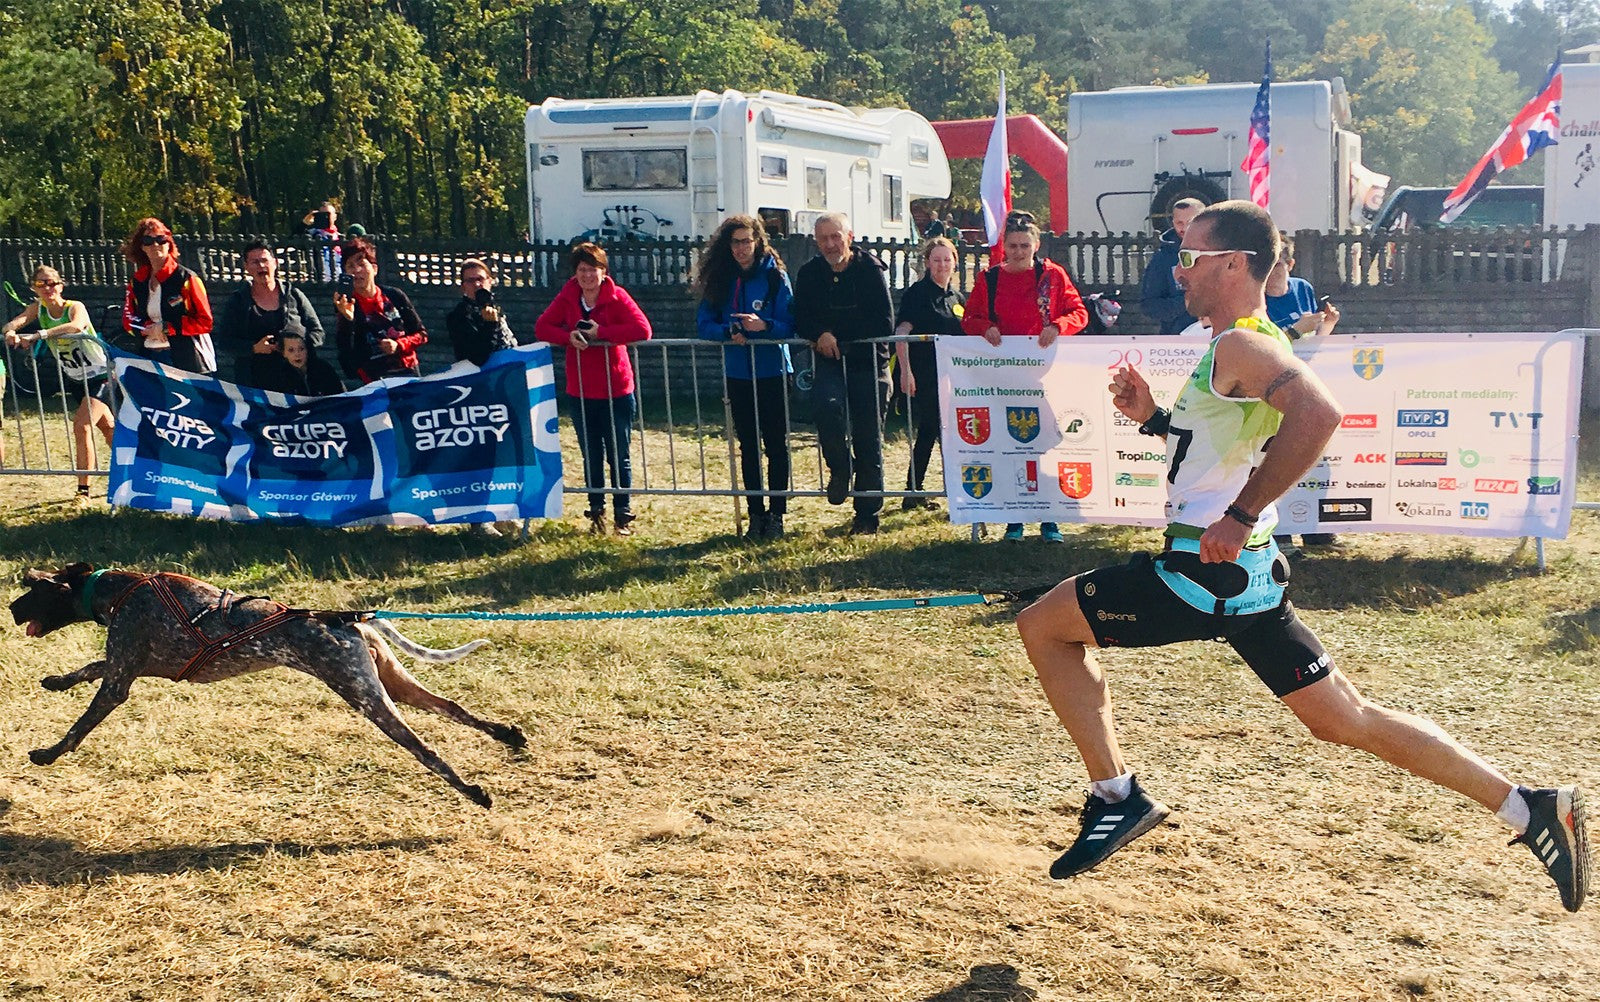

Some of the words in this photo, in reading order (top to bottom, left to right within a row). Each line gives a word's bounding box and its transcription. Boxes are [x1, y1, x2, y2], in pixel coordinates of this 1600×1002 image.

[1150, 348, 1196, 357] POLSKA
[952, 356, 1045, 368] Współorganizator:
[1149, 358, 1201, 367] SAMORZ
[954, 387, 995, 397] Komitet
[1407, 389, 1457, 399] Patronat
[1461, 389, 1518, 400] medialny:
[1354, 453, 1386, 463] ACK
[412, 486, 467, 500] Sponsor
[470, 481, 524, 494] Główny
[259, 490, 308, 502] Sponsor
[311, 491, 357, 503] Główny
[1461, 501, 1488, 517] nto
